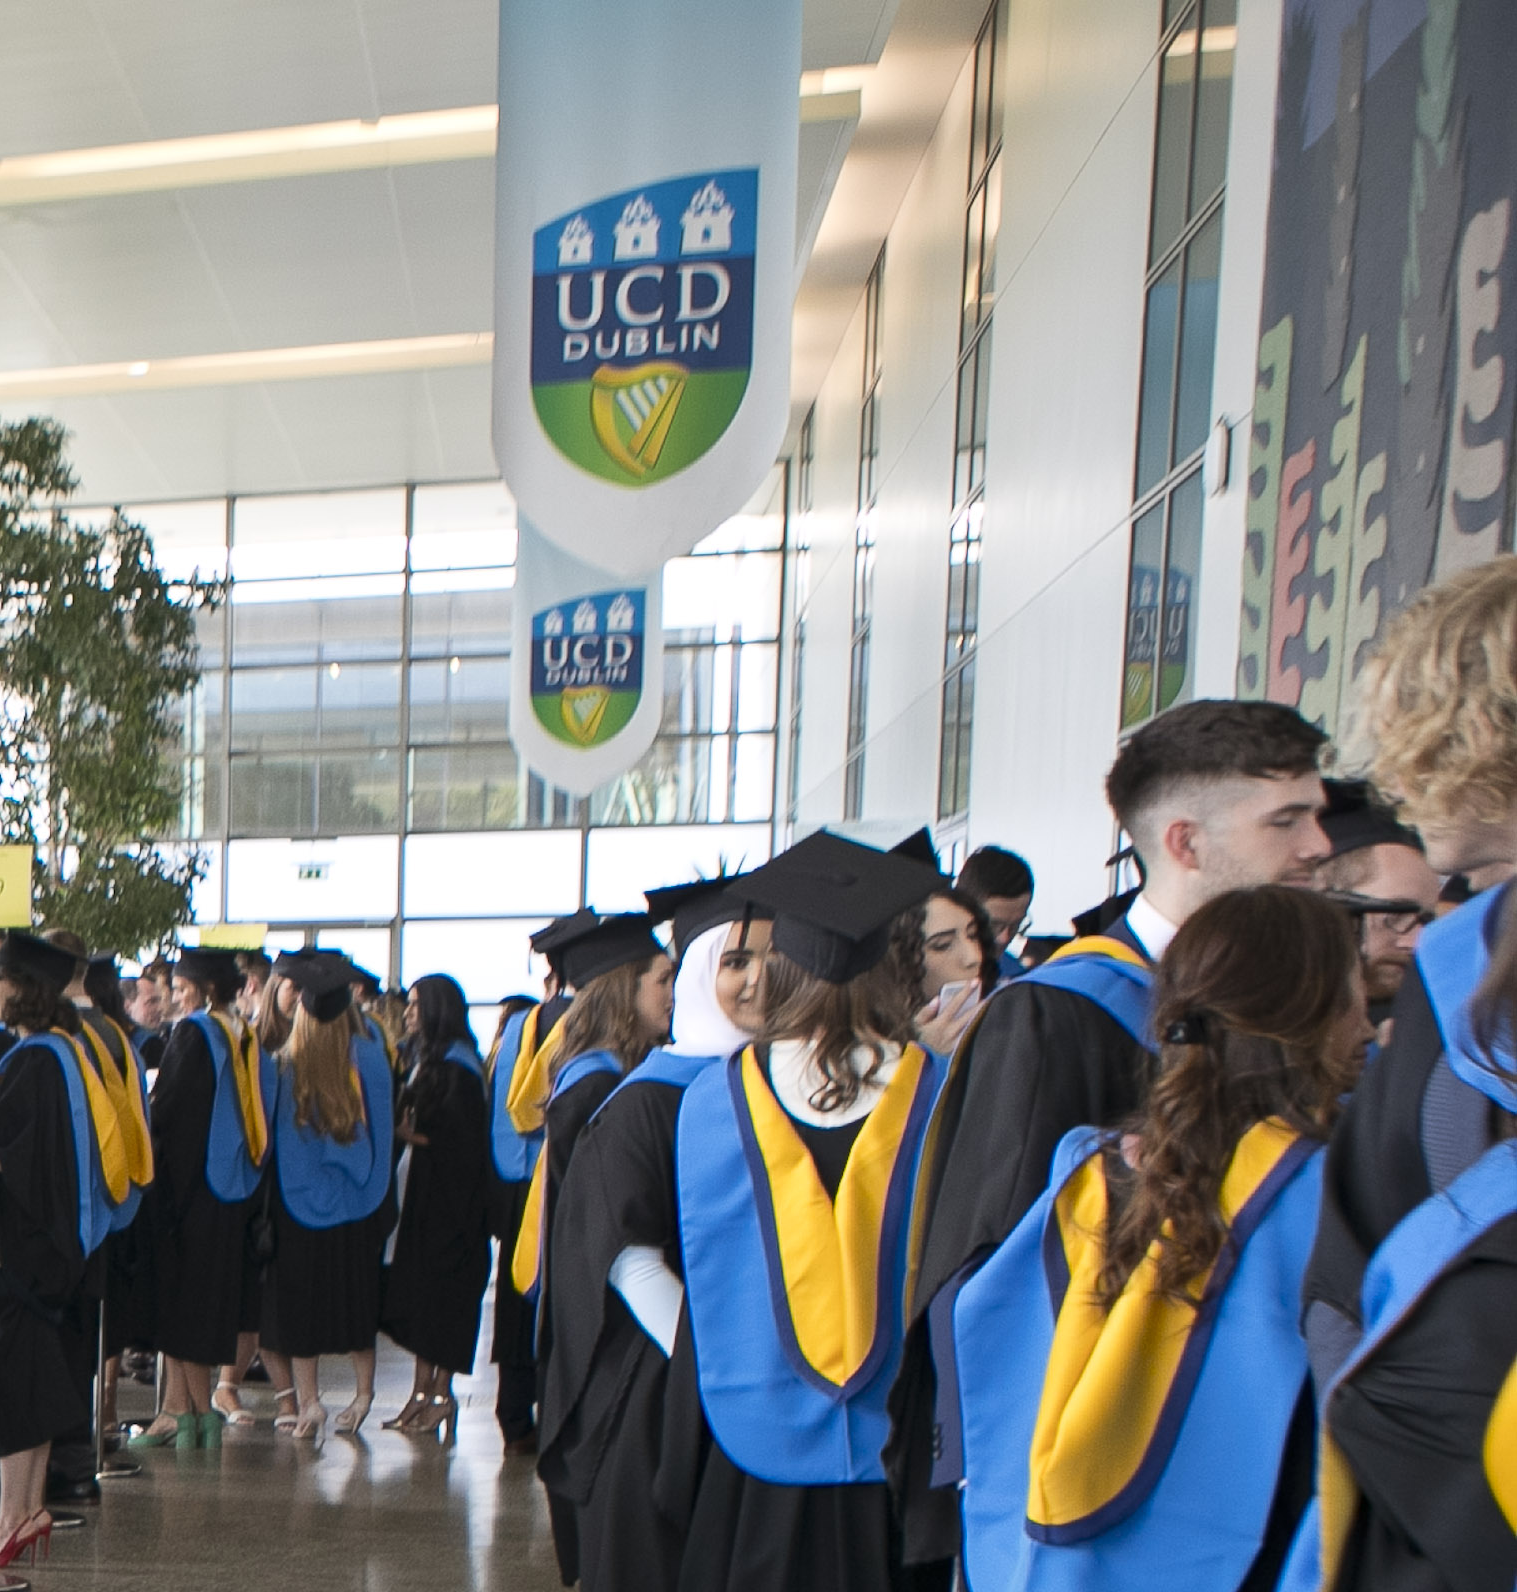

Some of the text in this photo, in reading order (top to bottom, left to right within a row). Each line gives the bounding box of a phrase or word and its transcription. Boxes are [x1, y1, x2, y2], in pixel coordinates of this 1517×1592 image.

[557, 262, 732, 331] UCD
[563, 321, 721, 363] DUBLIN
[543, 633, 634, 670] UCD
